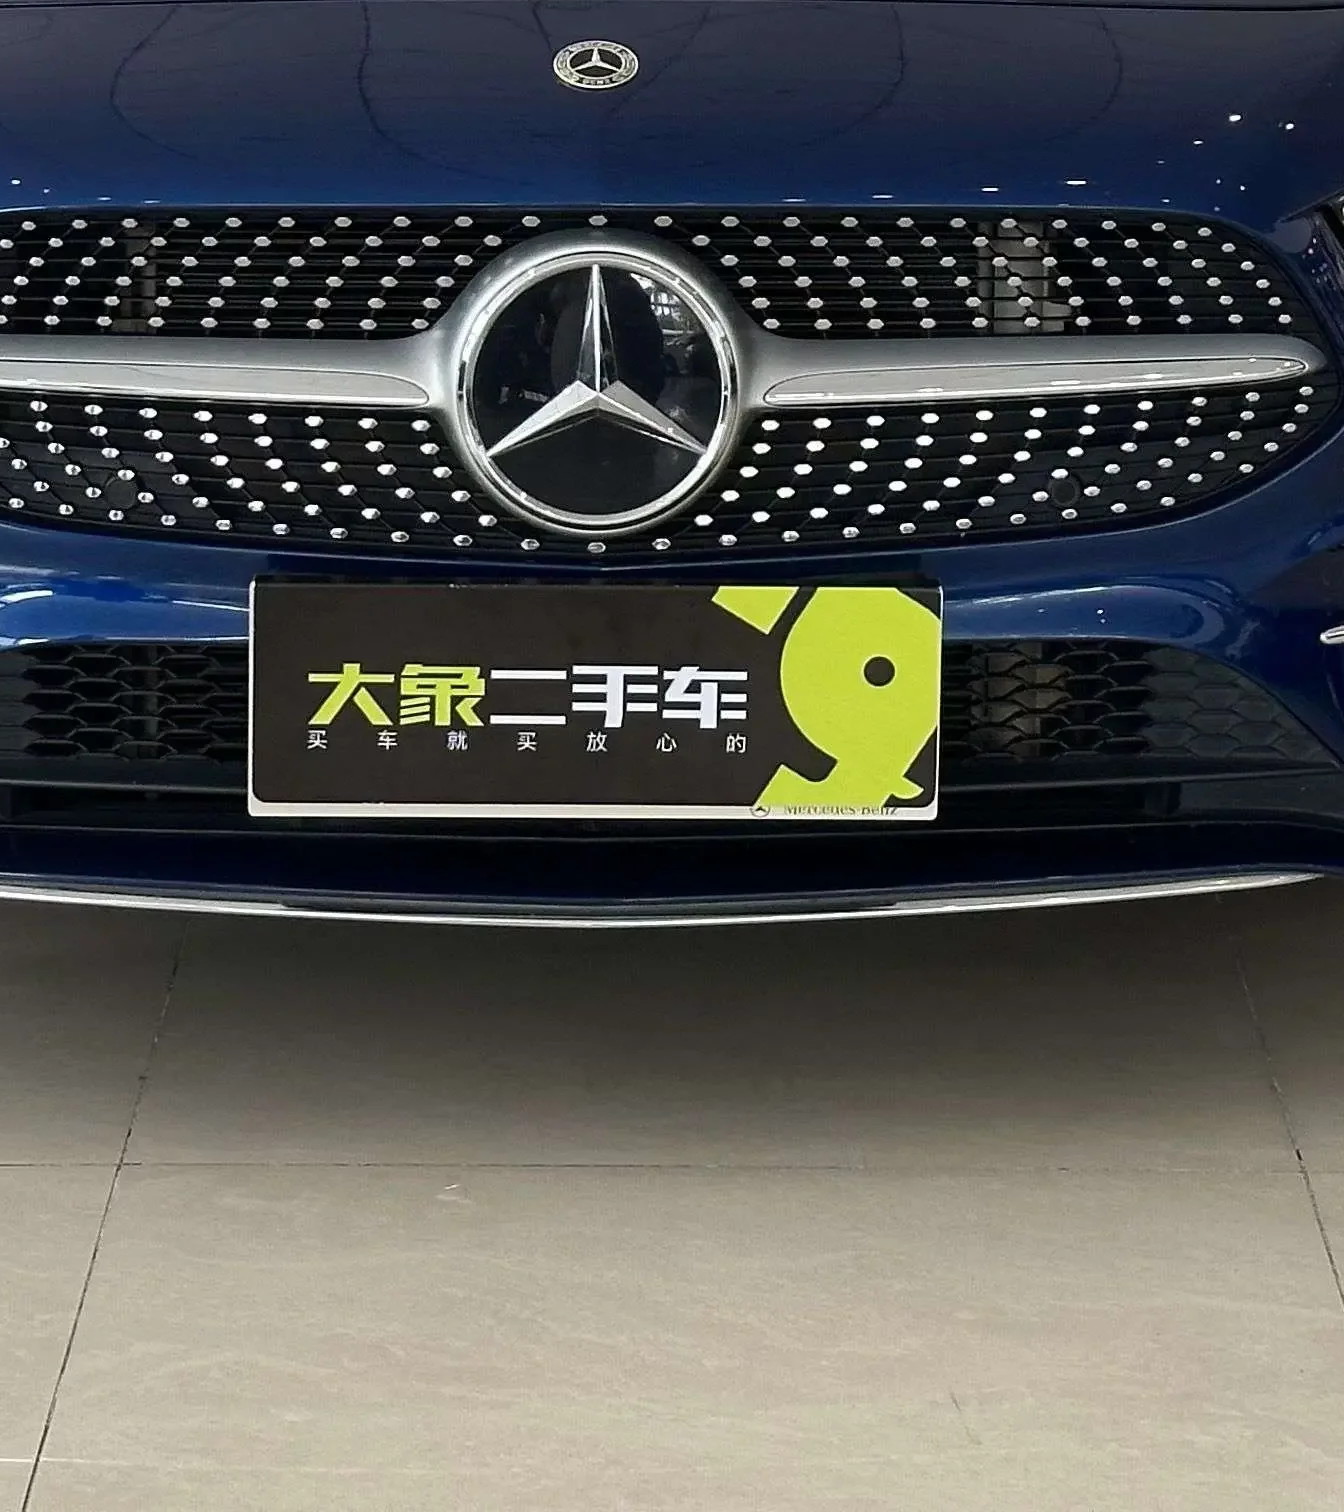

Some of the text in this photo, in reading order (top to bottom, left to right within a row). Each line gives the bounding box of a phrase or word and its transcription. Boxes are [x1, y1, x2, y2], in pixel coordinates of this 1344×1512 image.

[307, 662, 749, 730] 大象二手车
[306, 729, 748, 754] 买车就买放心的
